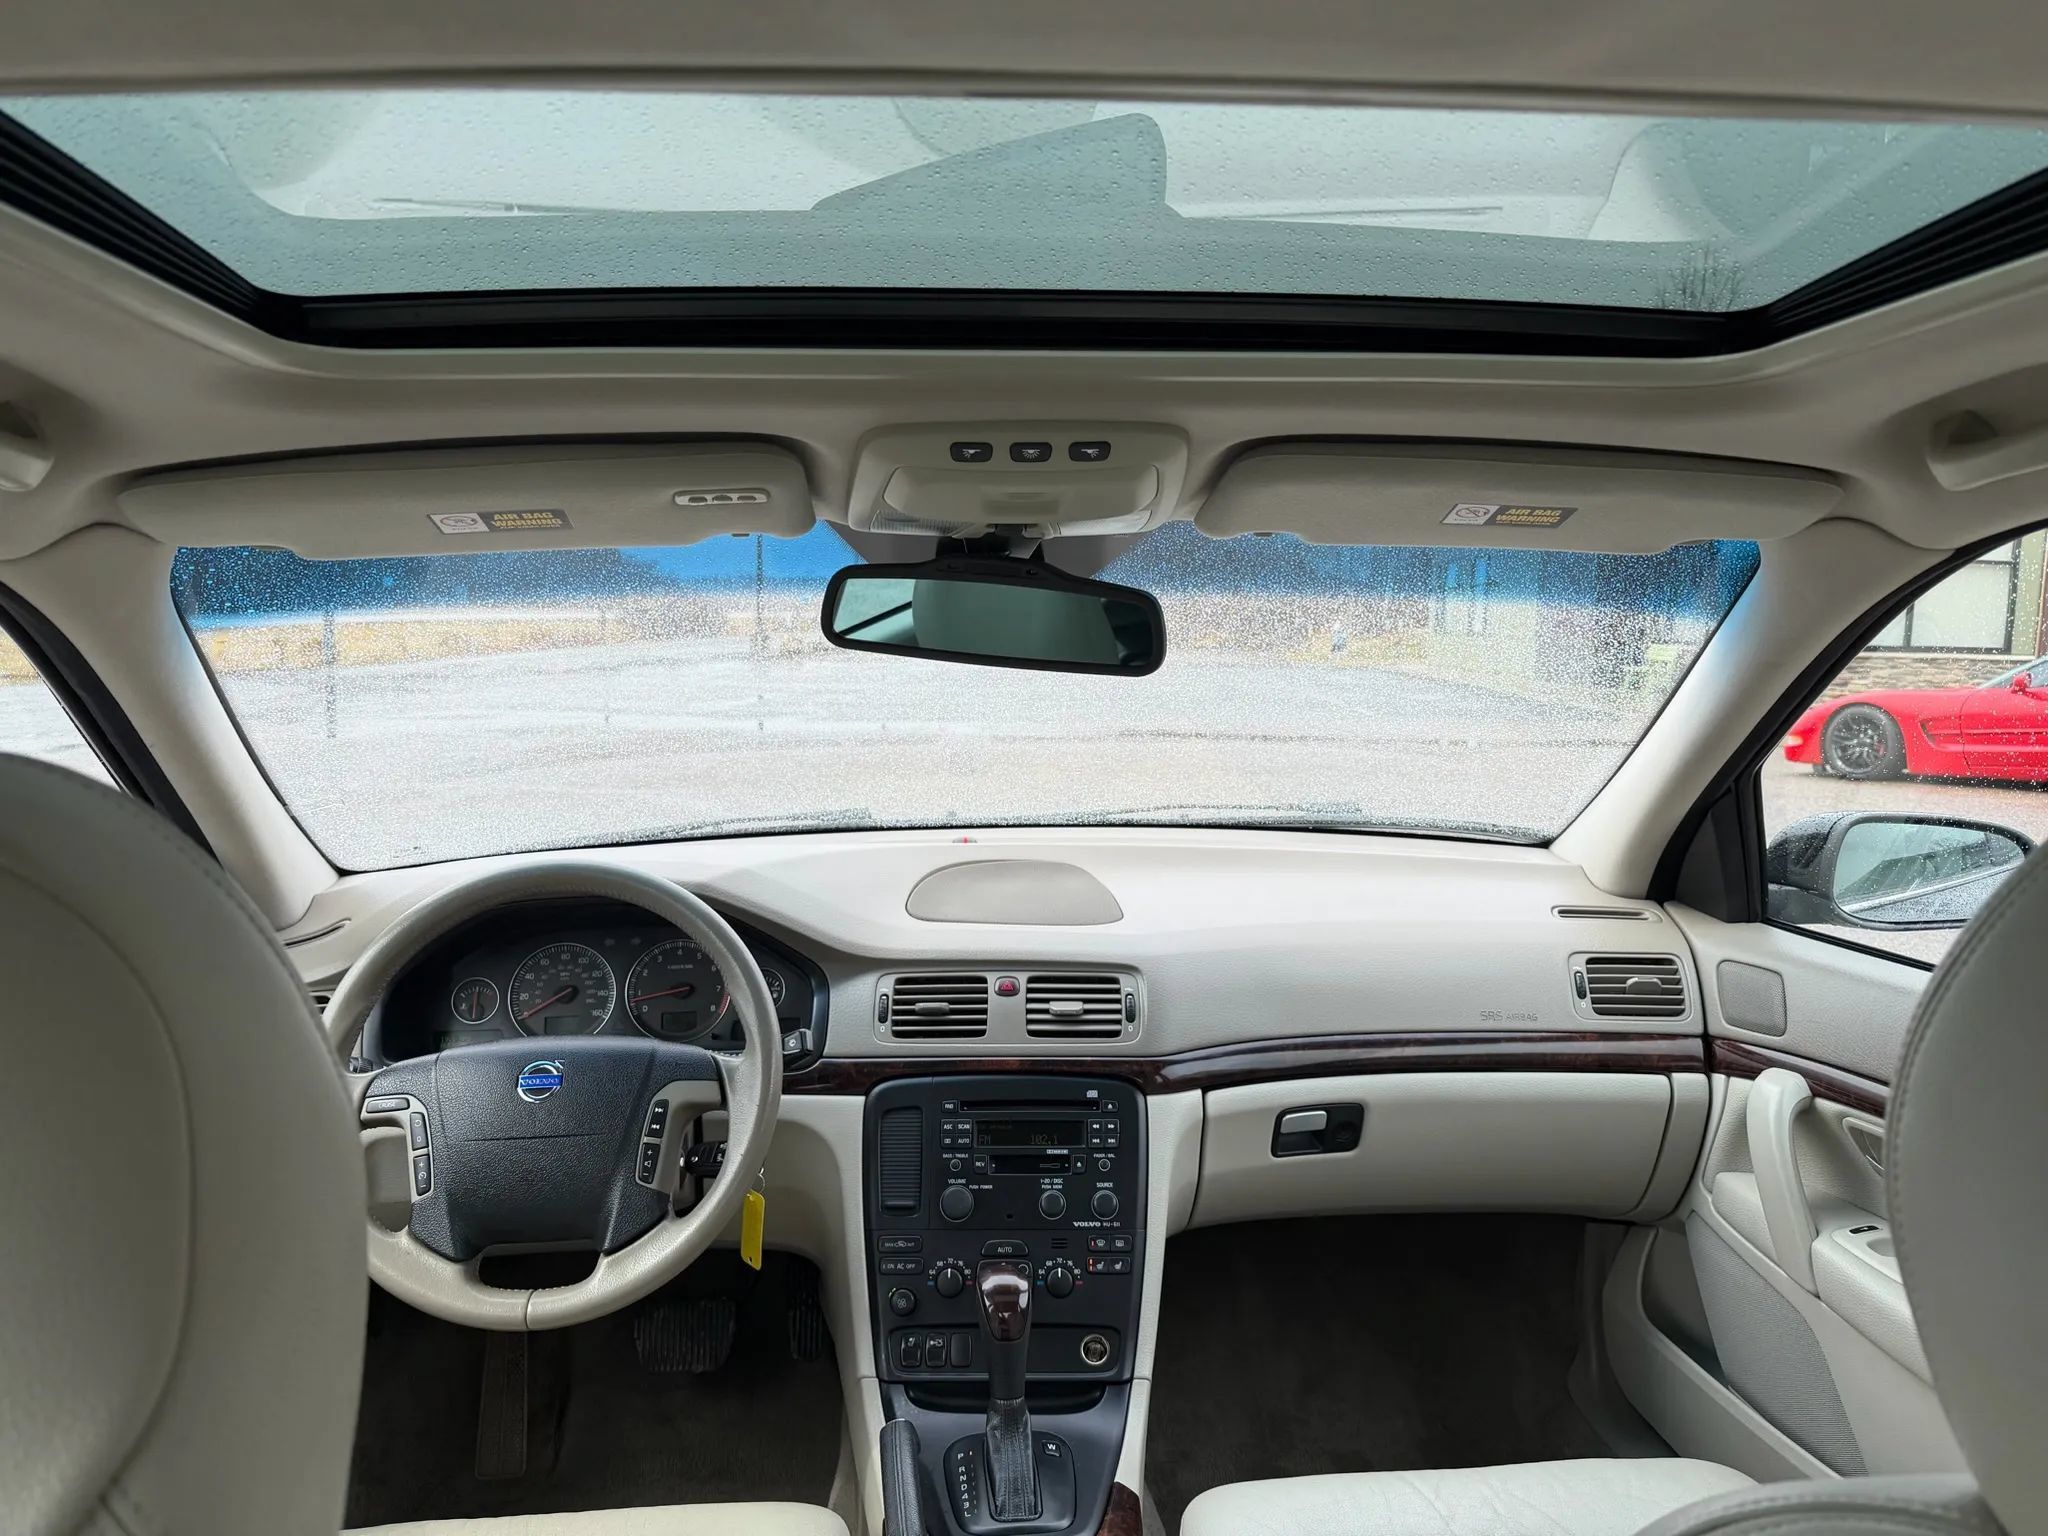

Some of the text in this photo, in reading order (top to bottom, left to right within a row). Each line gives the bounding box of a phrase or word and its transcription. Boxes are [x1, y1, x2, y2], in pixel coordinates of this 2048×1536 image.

[490, 518, 563, 527] WARNING
[1495, 514, 1560, 523] WARNING
[1480, 1010, 1538, 1021] SRS AIRBAG
[520, 1078, 560, 1086] VOLVO
[896, 1262, 905, 1270] AC
[961, 1483, 968, 1491] D
[963, 1501, 970, 1509] 3
